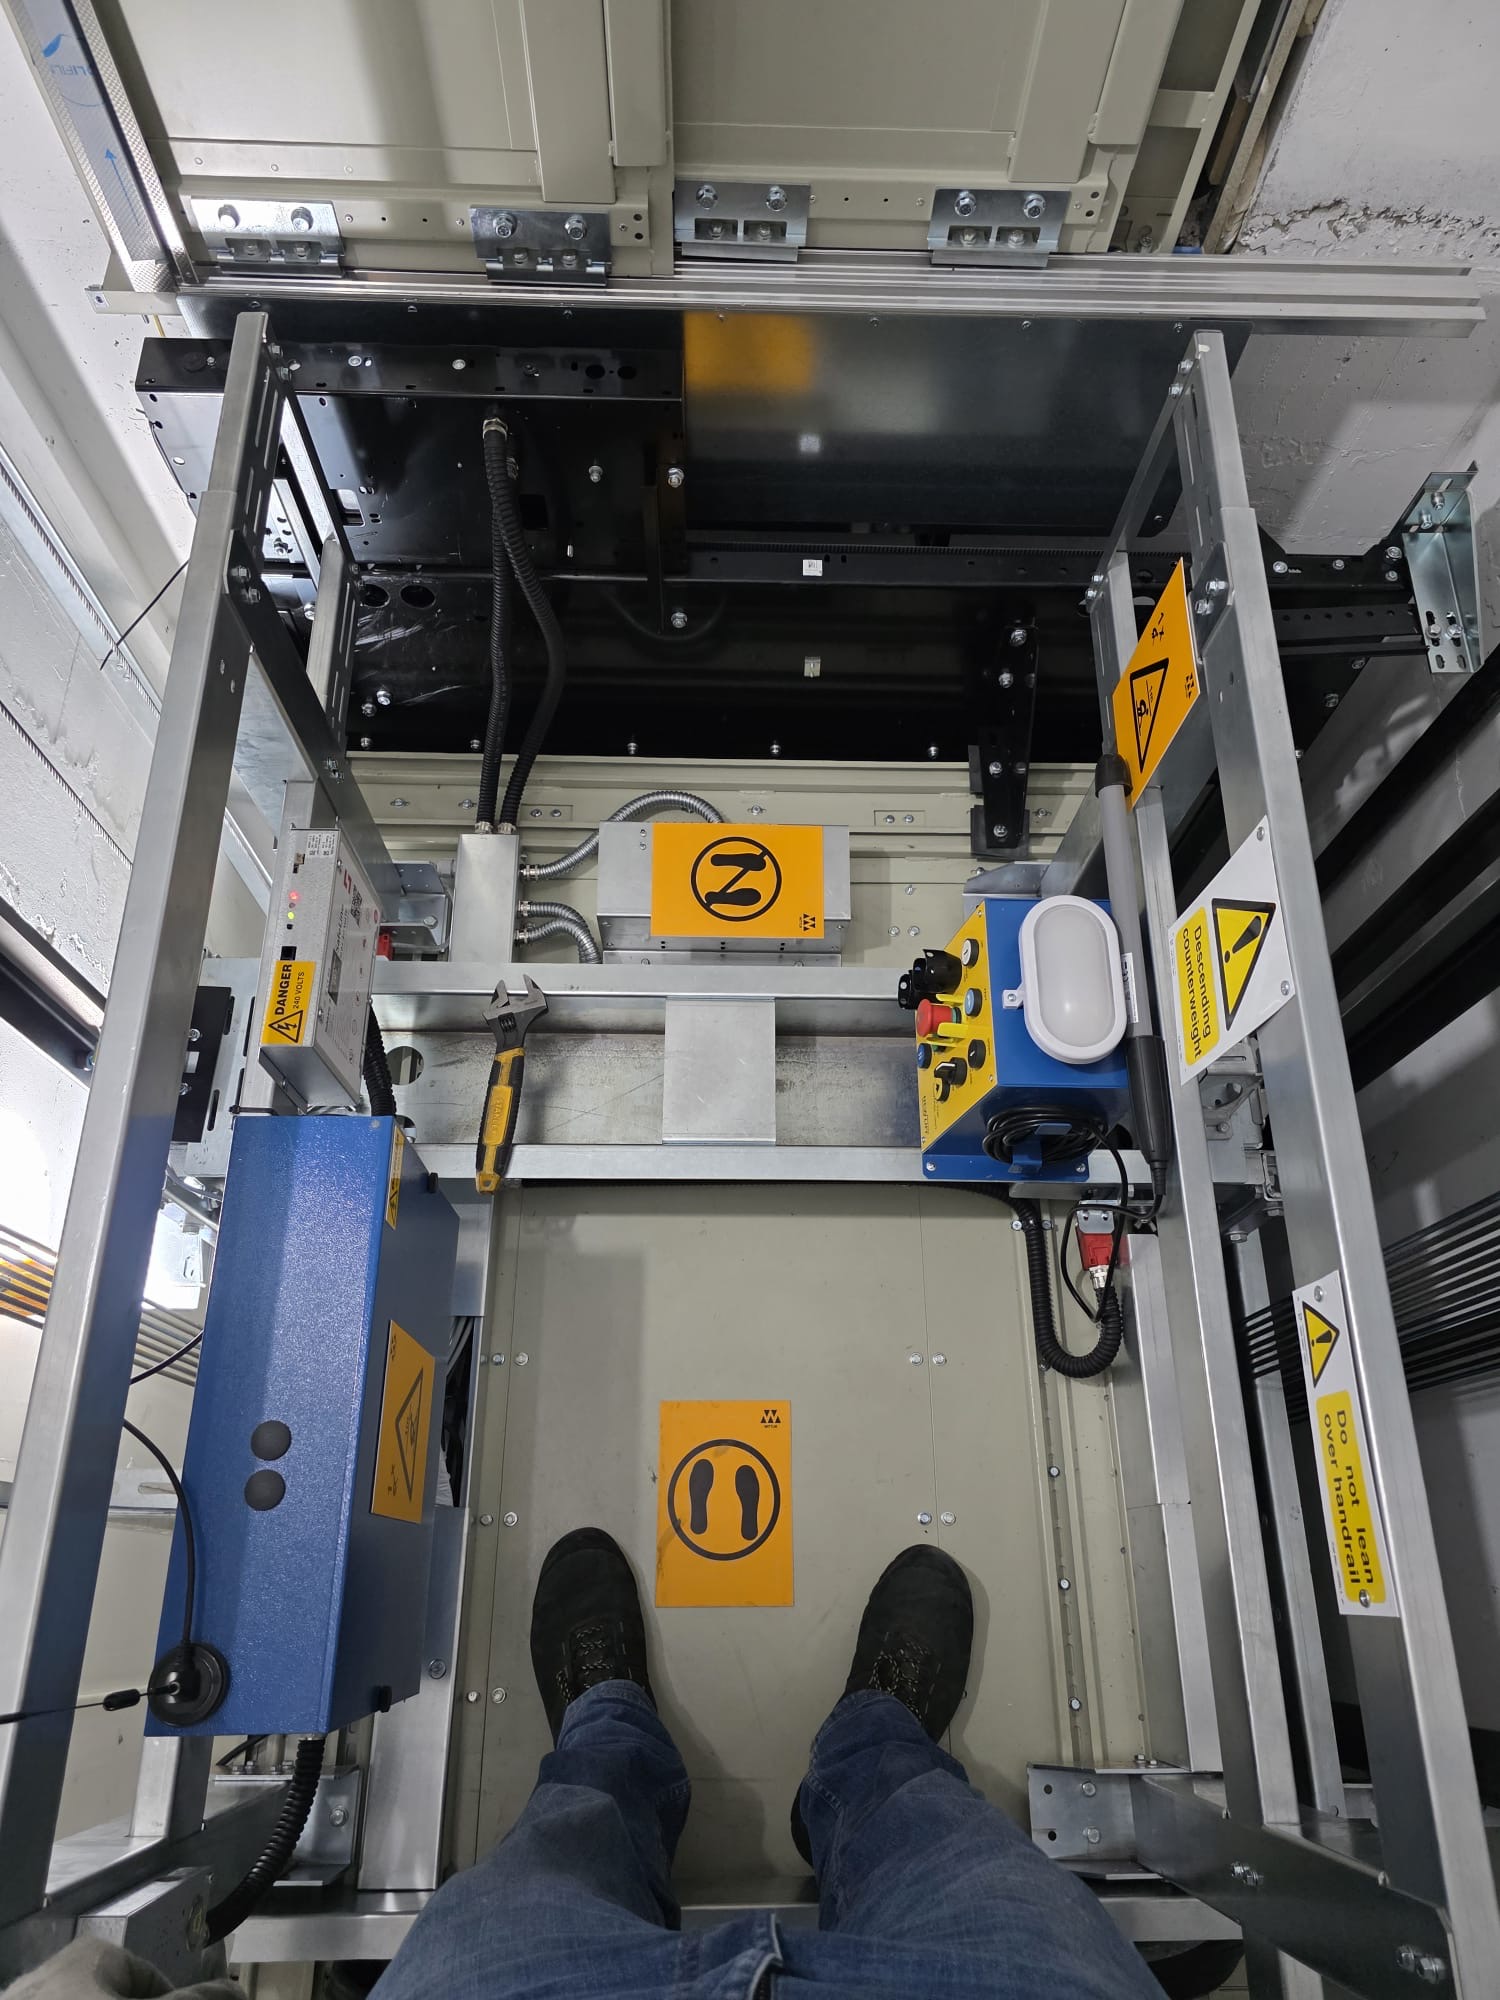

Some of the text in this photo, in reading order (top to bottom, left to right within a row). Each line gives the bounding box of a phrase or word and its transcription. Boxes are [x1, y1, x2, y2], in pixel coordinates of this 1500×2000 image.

[275, 964, 292, 1015] DANGER
[293, 971, 305, 1010] 240 VOLTS
[1183, 928, 1202, 1058] counterweight
[1194, 926, 1211, 1038] Descending
[1324, 1413, 1339, 1467] over
[1333, 1477, 1361, 1584] handrail
[1337, 1410, 1373, 1584] Do not lean
